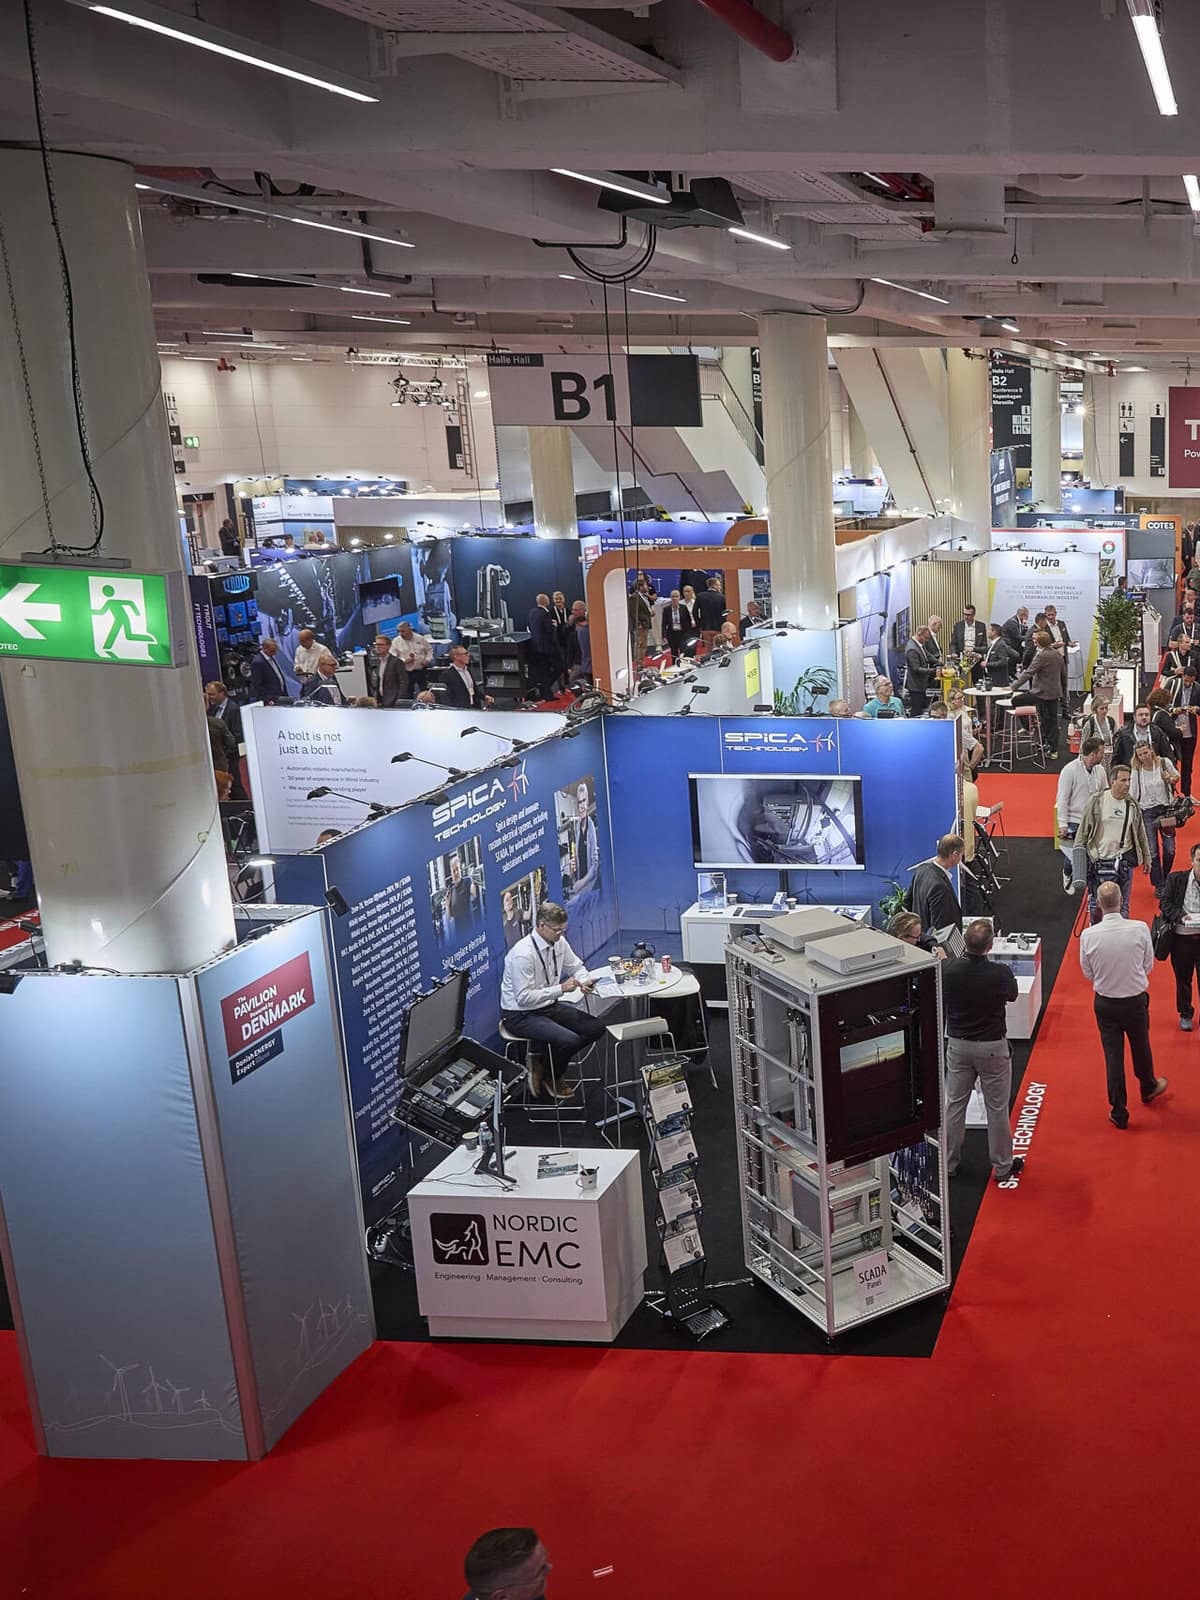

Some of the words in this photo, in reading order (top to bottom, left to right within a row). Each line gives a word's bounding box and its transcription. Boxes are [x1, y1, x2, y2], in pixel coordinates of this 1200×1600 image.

[489, 355, 511, 365] Halle
[513, 355, 530, 365] Hall
[992, 376, 1008, 386] B2
[551, 372, 616, 421] B1
[1147, 521, 1175, 530] COTES
[642, 538, 655, 546] top
[1021, 556, 1061, 570] Hydra
[278, 730, 286, 740] A
[288, 730, 310, 741] bolt
[313, 732, 321, 741] is
[323, 733, 342, 742] not
[279, 744, 300, 756] just
[302, 747, 309, 755] a
[311, 745, 333, 755] bolt
[725, 745, 809, 753] TECHNOLOGY
[434, 799, 507, 843] TECHNOLOGY
[233, 984, 278, 1020] PAVILION
[241, 988, 307, 1041] DENMARK
[1012, 1081, 1048, 1151] TECHNOLOGY
[492, 1213, 579, 1233] NORDIC
[495, 1240, 582, 1270] EMC
[434, 1271, 481, 1282] Engineering
[486, 1274, 537, 1284] Management
[542, 1275, 583, 1286] Consulting
[857, 1264, 888, 1284] SCADA
[867, 1280, 883, 1290] Panel
